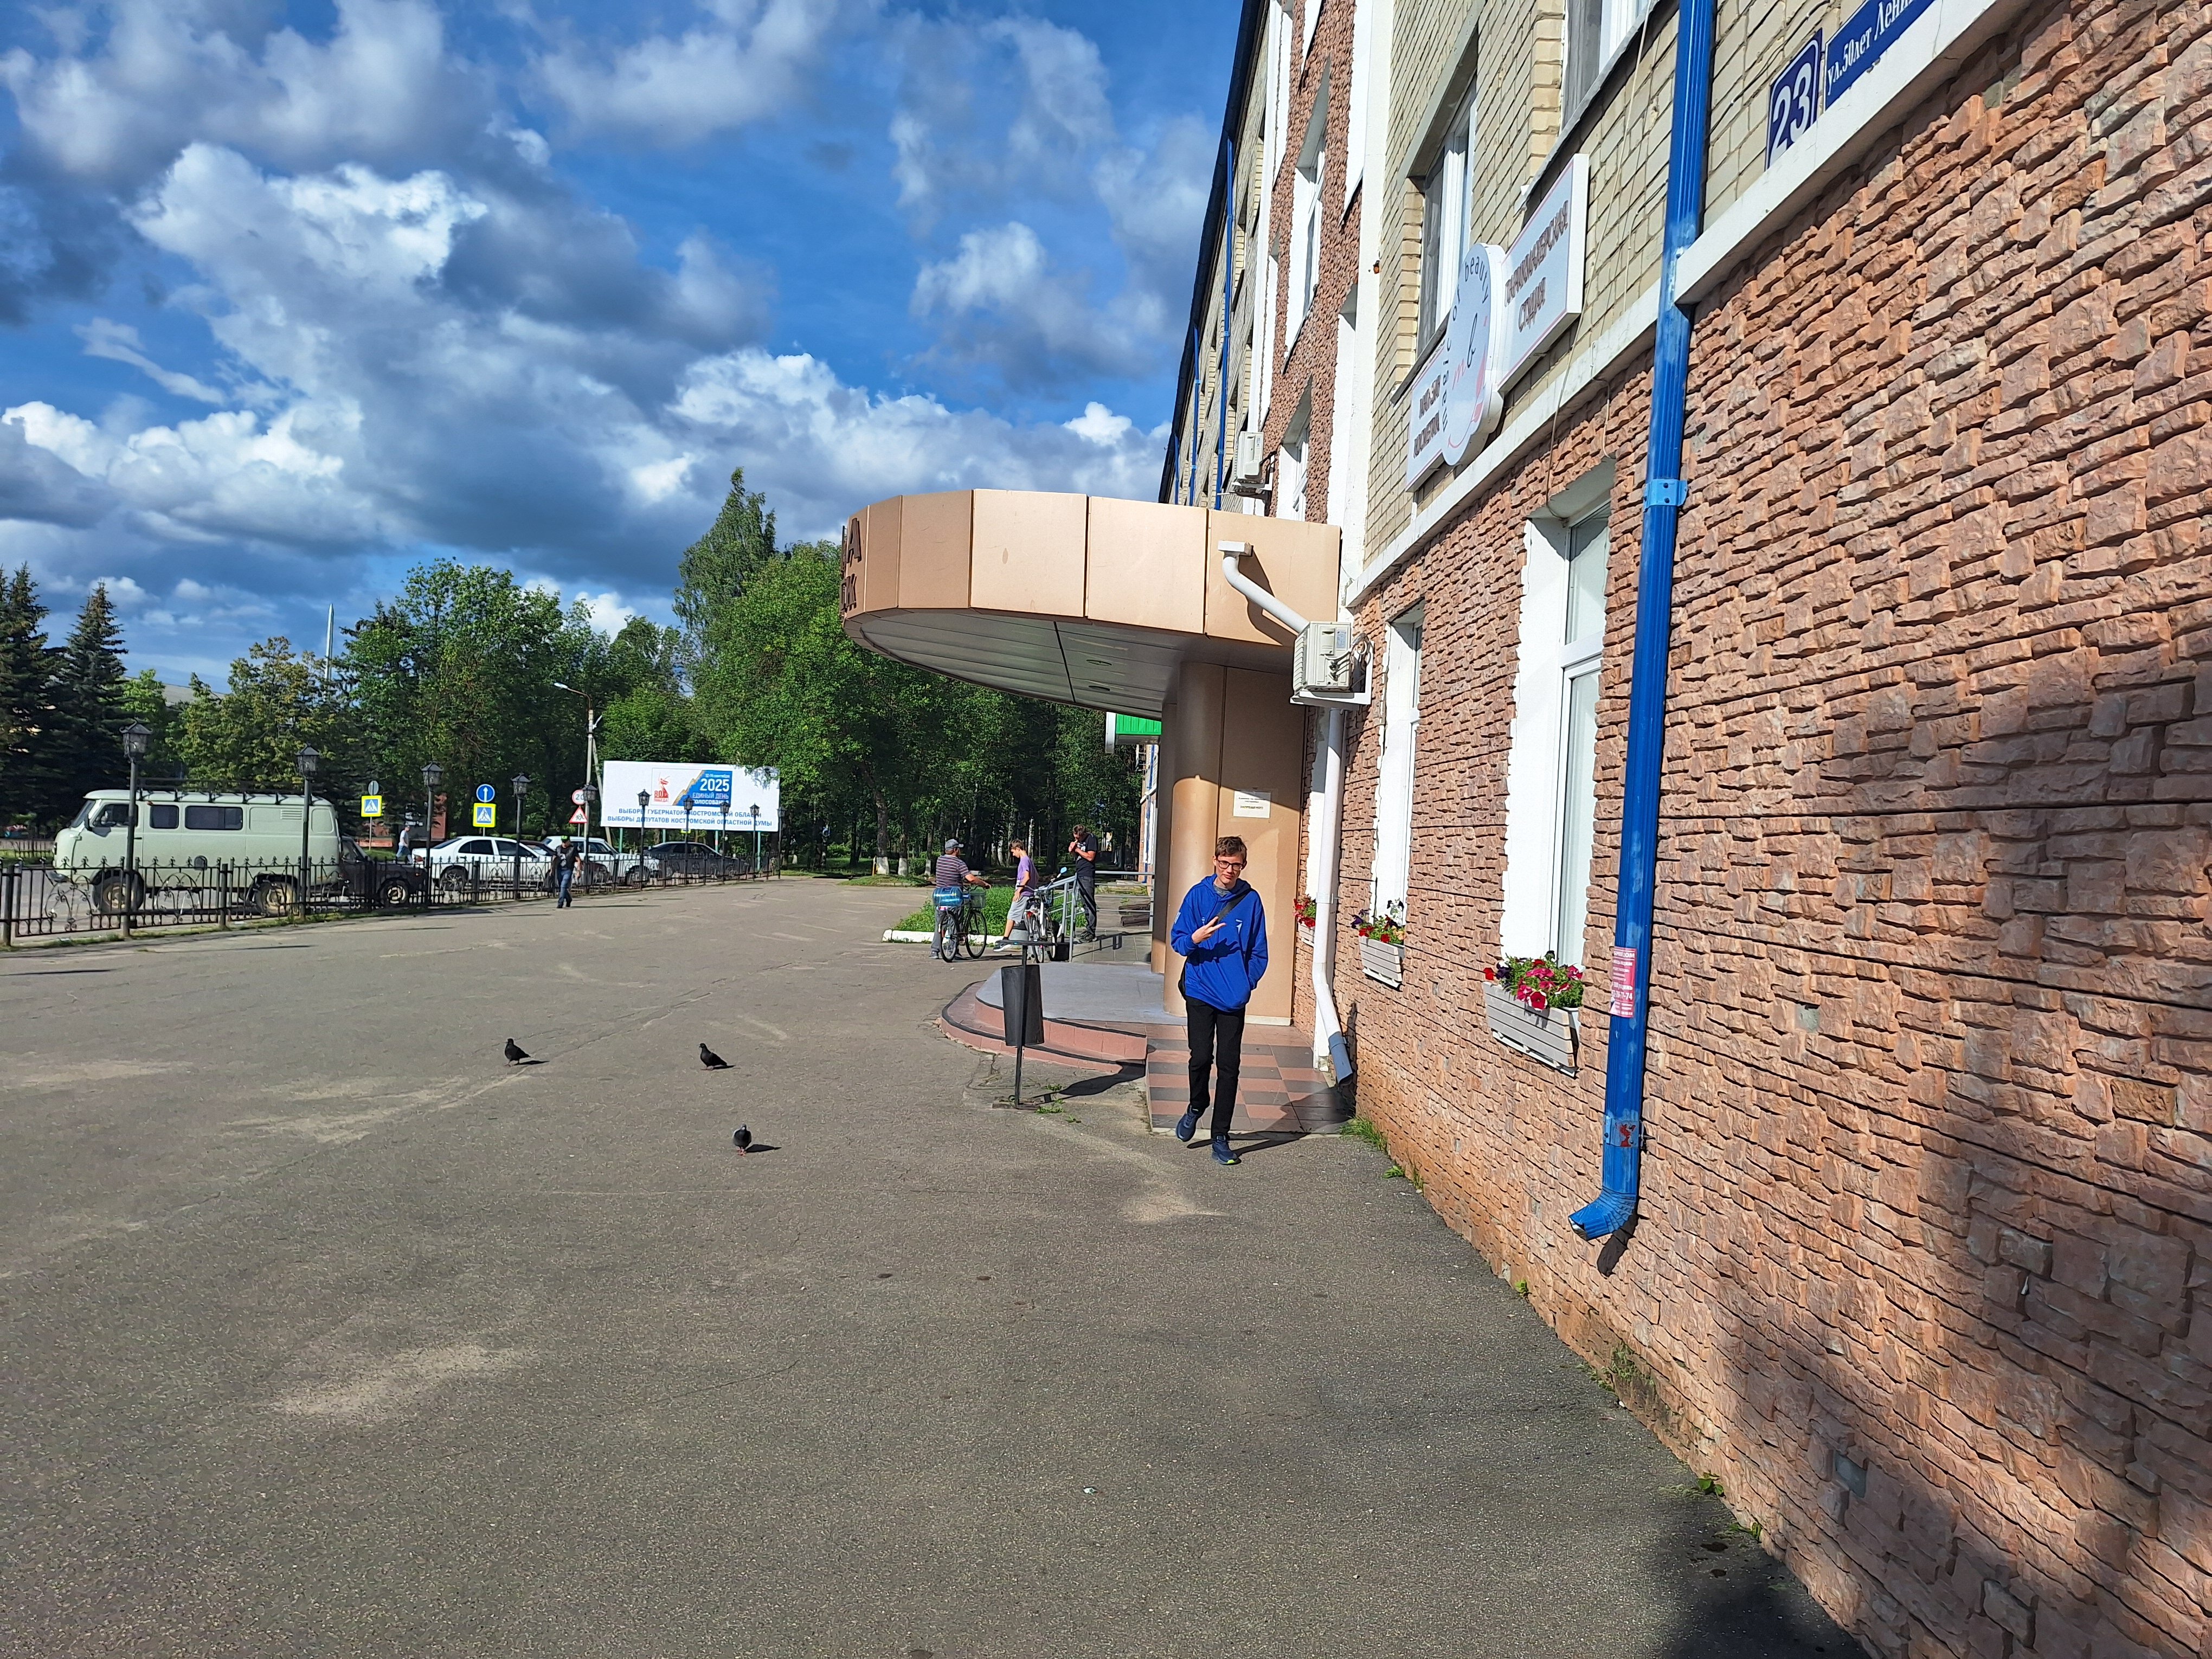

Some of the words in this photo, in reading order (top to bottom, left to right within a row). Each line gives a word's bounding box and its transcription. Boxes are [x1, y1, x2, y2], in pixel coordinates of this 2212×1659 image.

[1874, 0, 1913, 41] Лен
[1770, 62, 1812, 166] 23
[1442, 337, 1452, 432] magic
[1453, 284, 1461, 321] of
[1465, 256, 1488, 304] beauty
[700, 779, 730, 792] 2025
